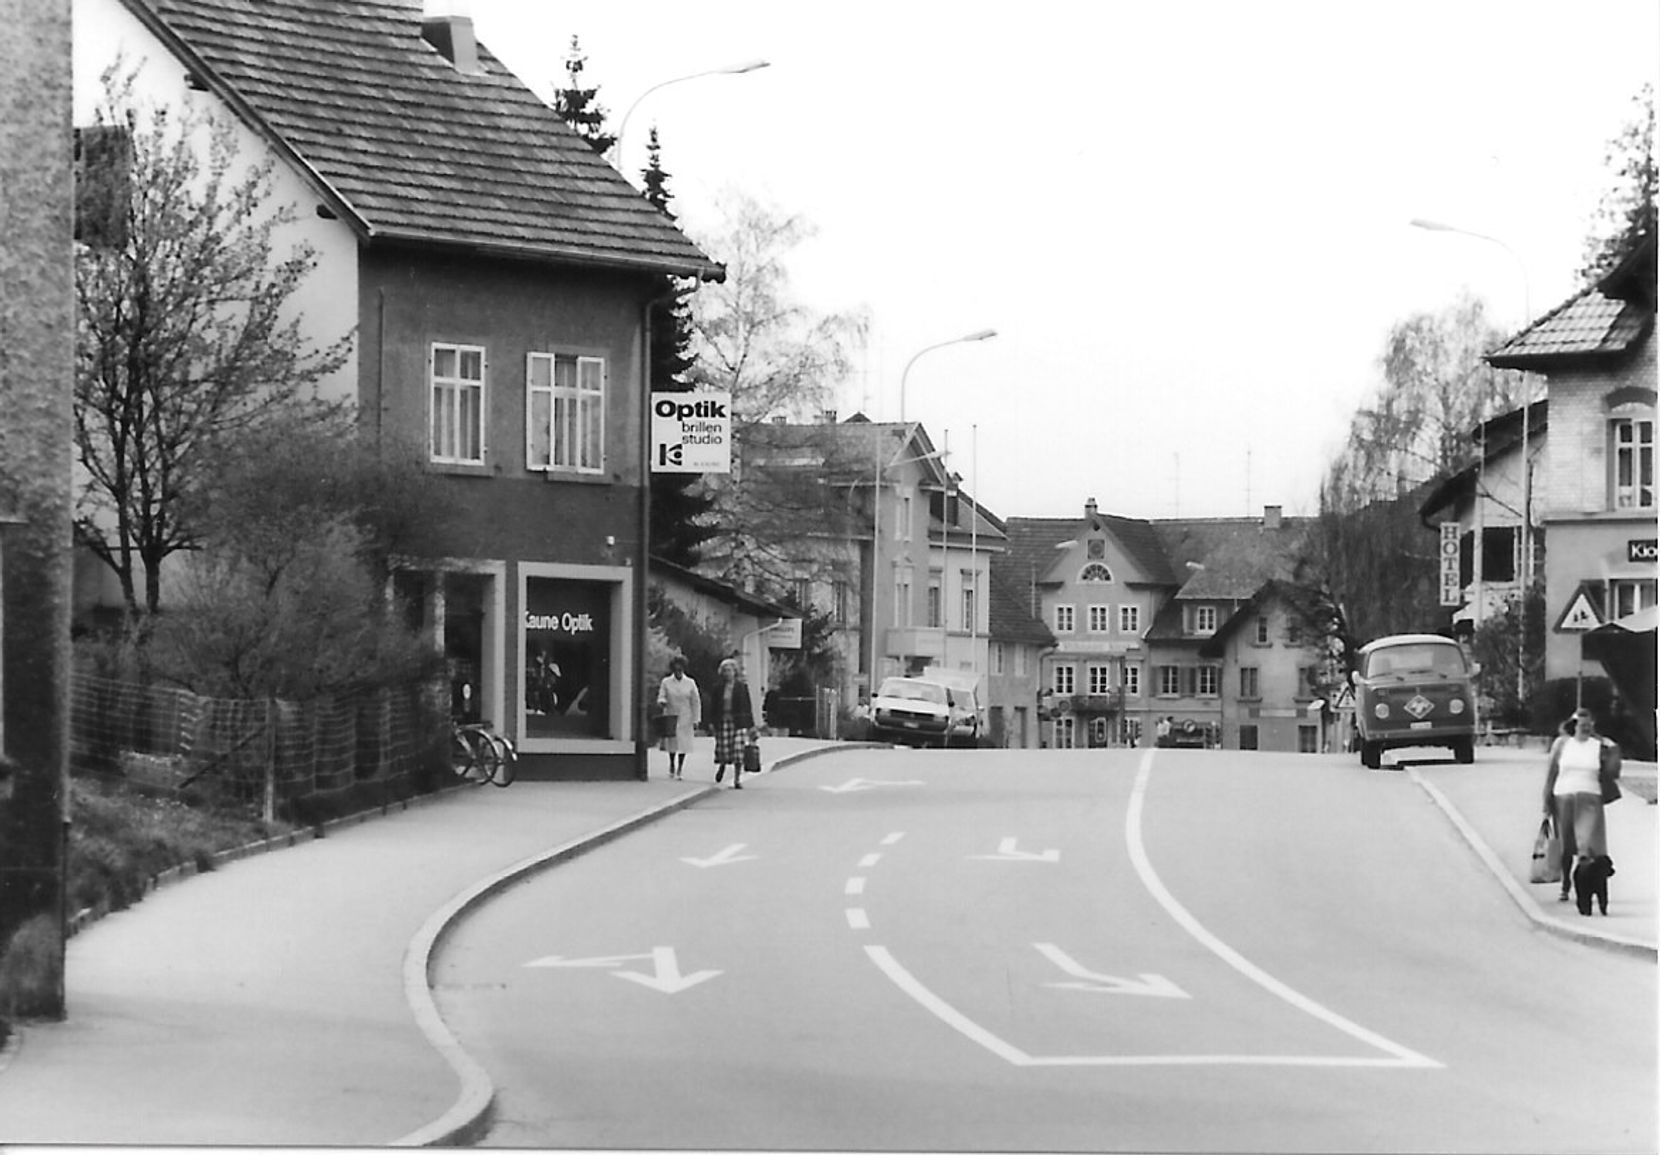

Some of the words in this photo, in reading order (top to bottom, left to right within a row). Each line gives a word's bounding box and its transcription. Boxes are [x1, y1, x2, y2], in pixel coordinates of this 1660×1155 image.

[655, 400, 726, 421] Optik
[682, 421, 722, 432] brillen
[682, 434, 722, 444] studio
[1443, 526, 1458, 603] HOTEL
[561, 612, 593, 635] Optik
